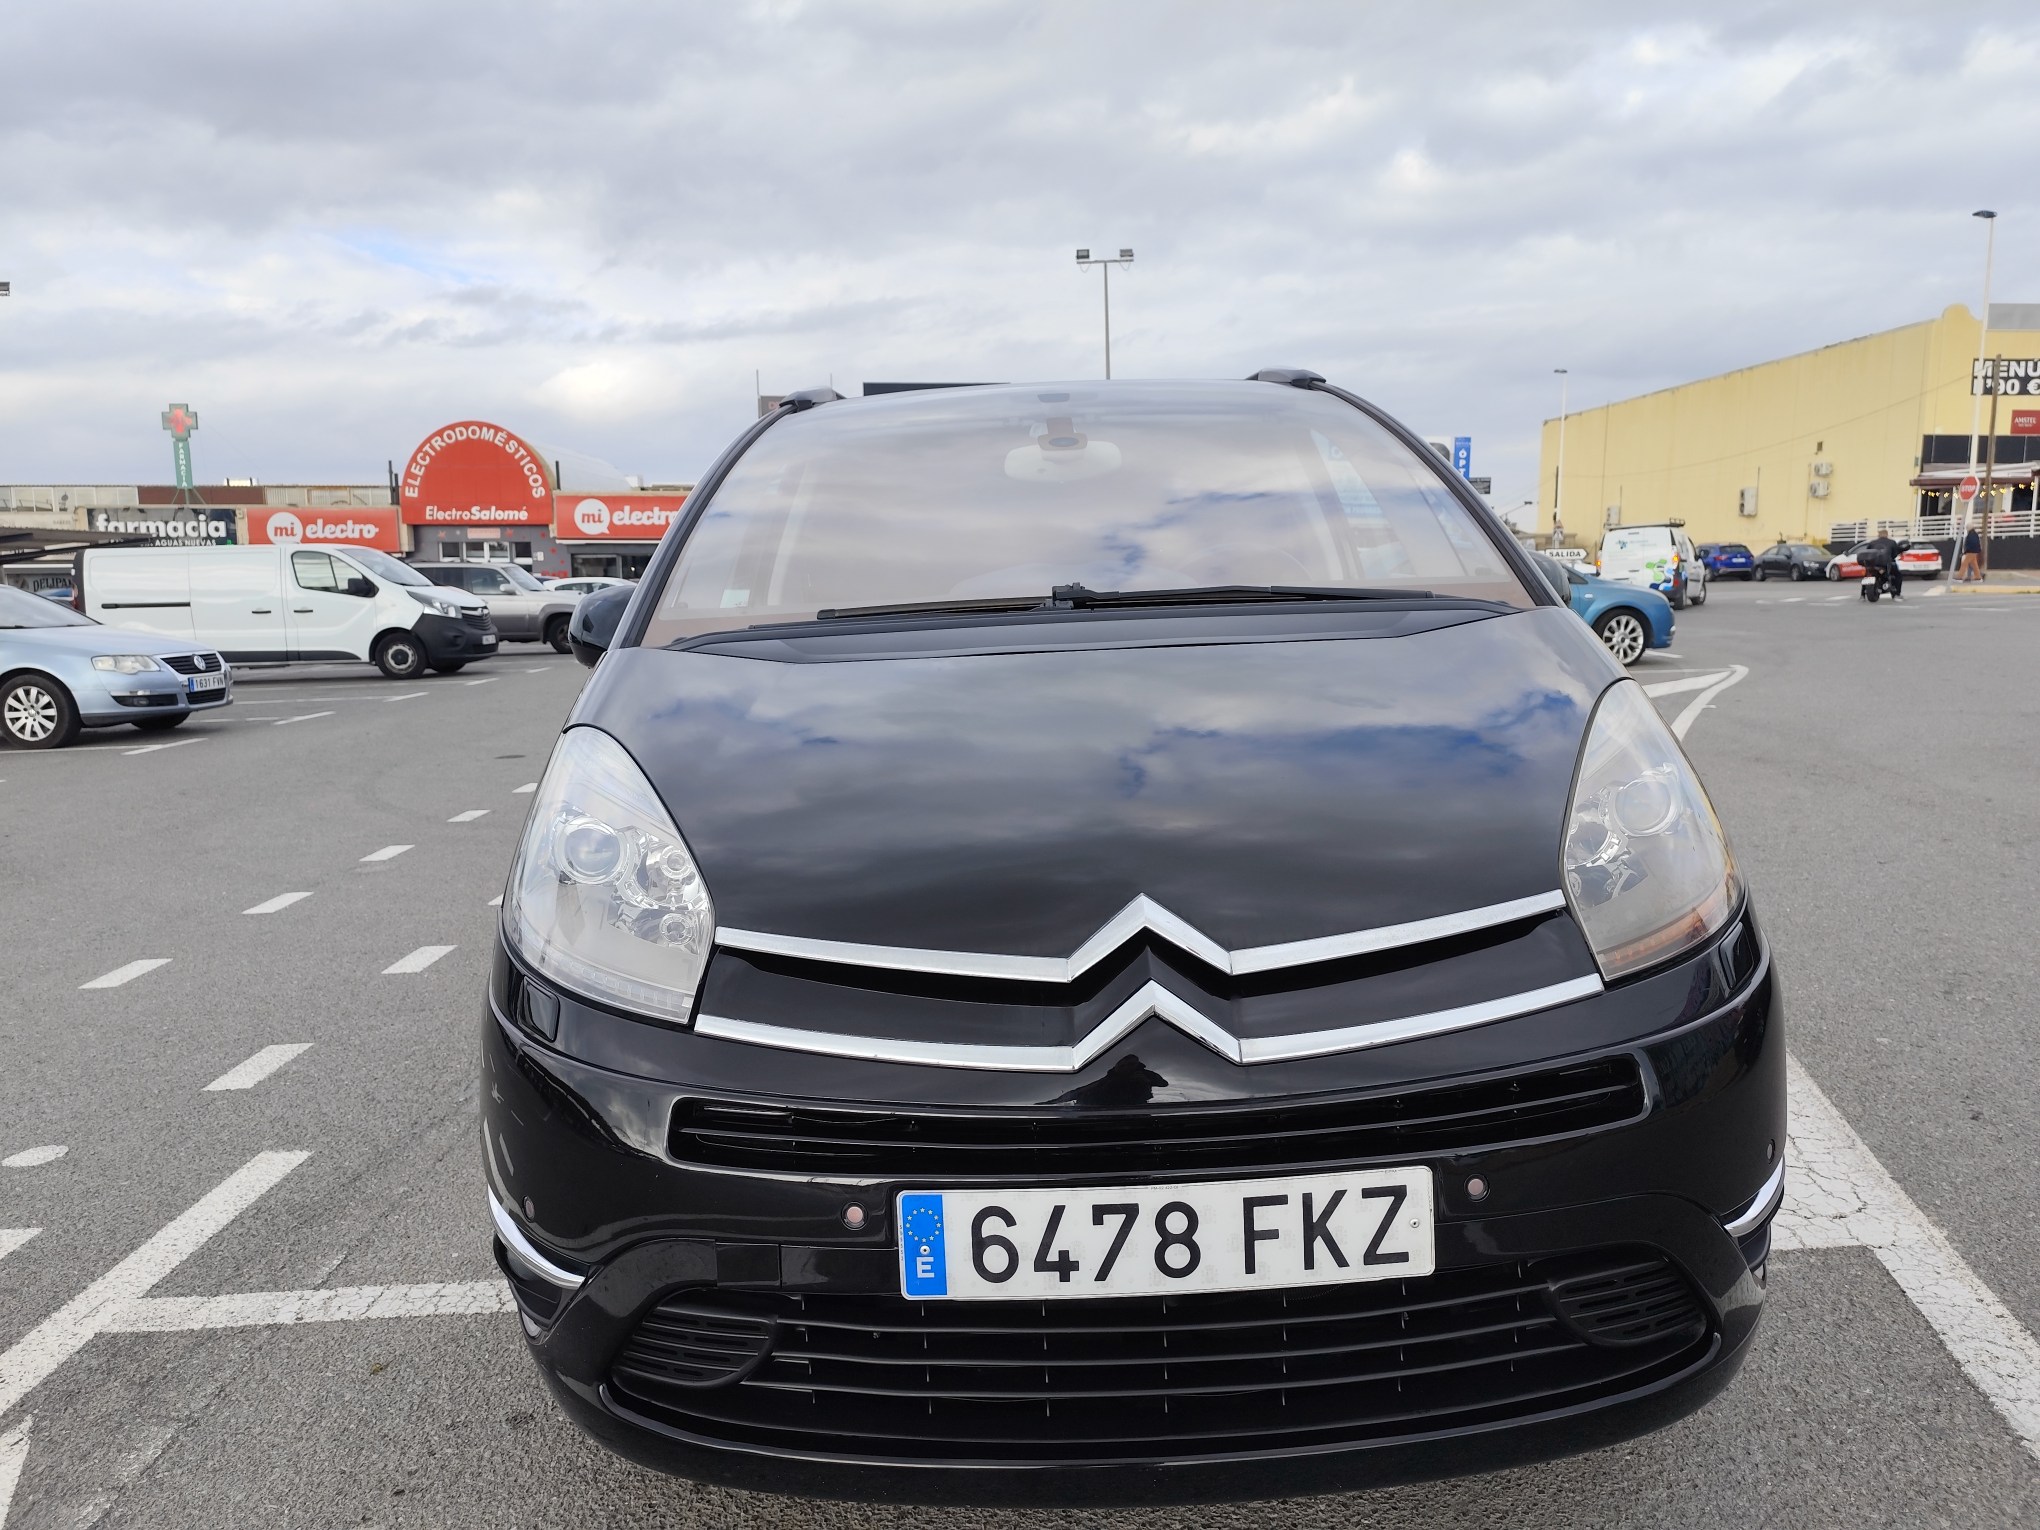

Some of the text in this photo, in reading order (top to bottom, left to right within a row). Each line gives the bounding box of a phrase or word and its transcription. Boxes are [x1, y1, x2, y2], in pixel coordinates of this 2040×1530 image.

[2014, 416, 2036, 424] AMSTEL
[178, 441, 188, 488] FARMACIA
[405, 425, 545, 498] ELECTRODOMÉSTICOS
[1961, 484, 1976, 493] STOP
[425, 505, 528, 521] ElectroSalomé
[581, 508, 605, 524] mi
[96, 513, 228, 538] farmacia
[273, 518, 380, 539] mi electro
[155, 539, 183, 547] AGUAS
[185, 539, 216, 547] NUEVAS
[970, 1200, 1201, 1284] 6478
[1242, 1184, 1409, 1275] FKZ
[915, 1256, 935, 1279] E
